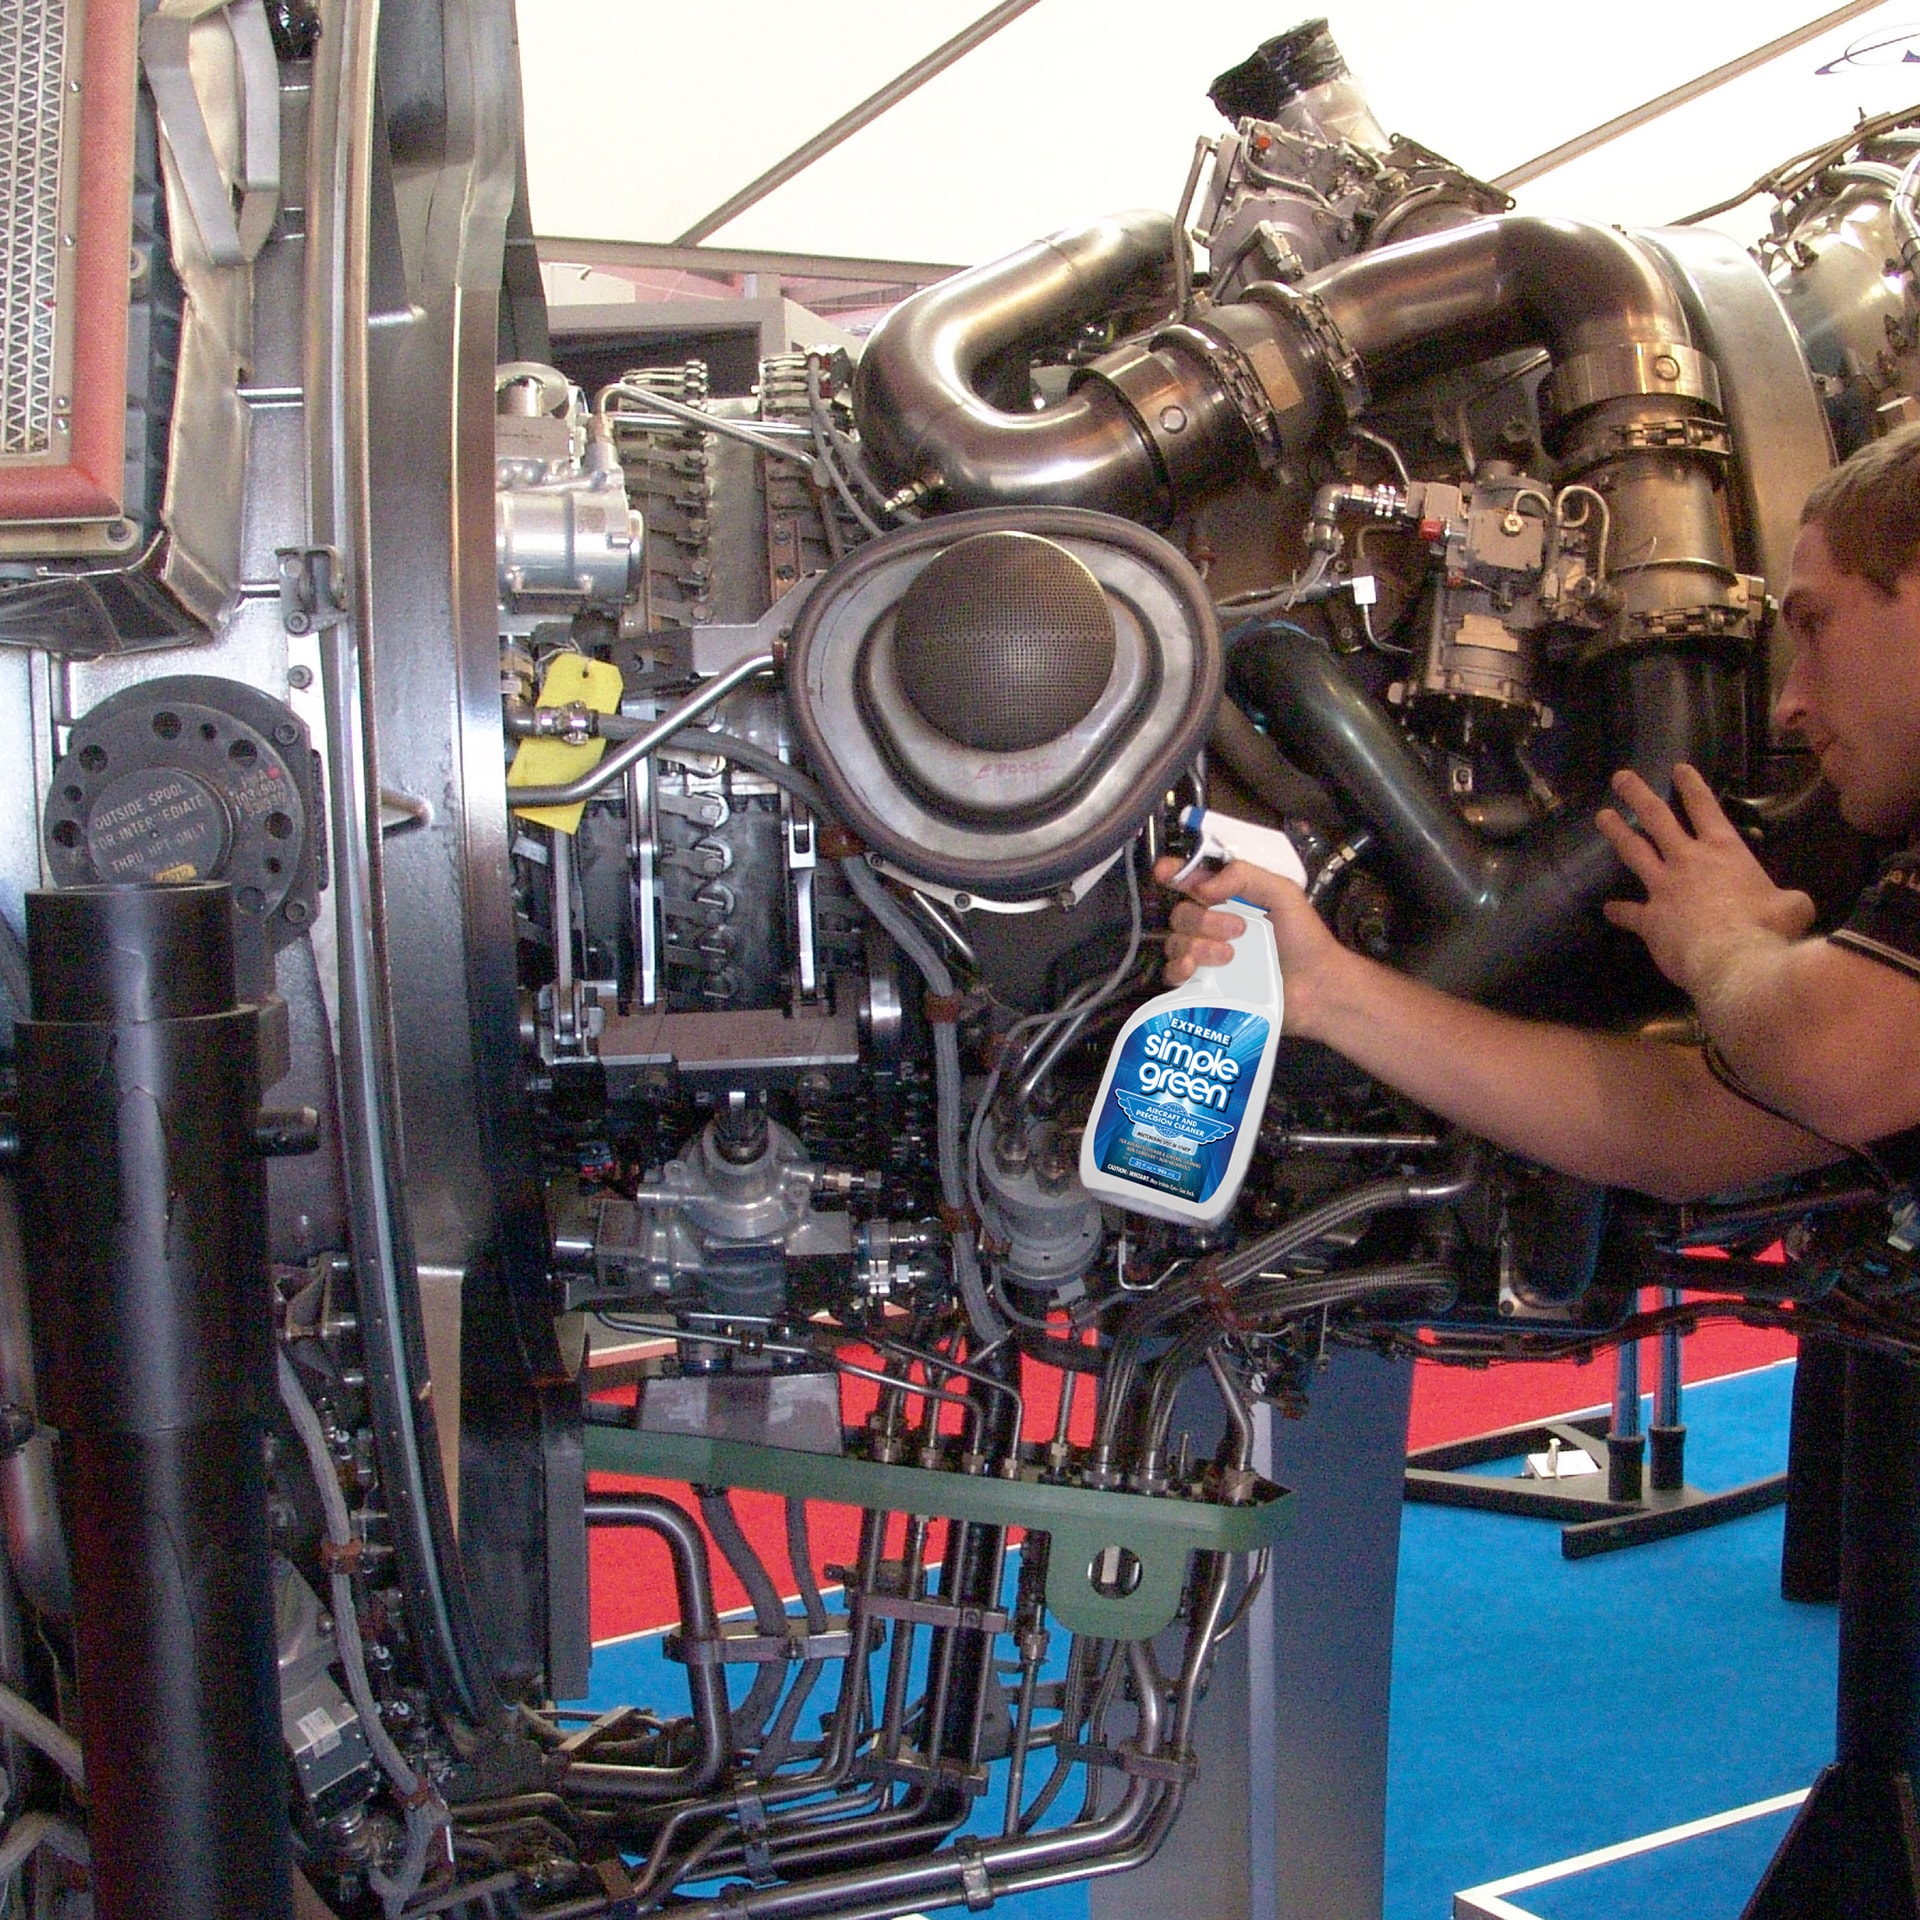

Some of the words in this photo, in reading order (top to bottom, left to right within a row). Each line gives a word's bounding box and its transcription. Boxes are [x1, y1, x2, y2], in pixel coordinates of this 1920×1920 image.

[93, 798, 145, 831] OUTSIDE
[147, 780, 186, 807] SPOOL
[110, 850, 145, 875] THRU
[174, 822, 208, 846] ONLY
[1144, 1029, 1240, 1082] simple
[1170, 1018, 1231, 1045] EXTREME
[1138, 1061, 1228, 1109] green
[1135, 1109, 1174, 1127] PRECISION
[1174, 1122, 1205, 1136] CLEANER
[1146, 1106, 1180, 1122] AIRCRAFT
[1181, 1117, 1198, 1127] AND
